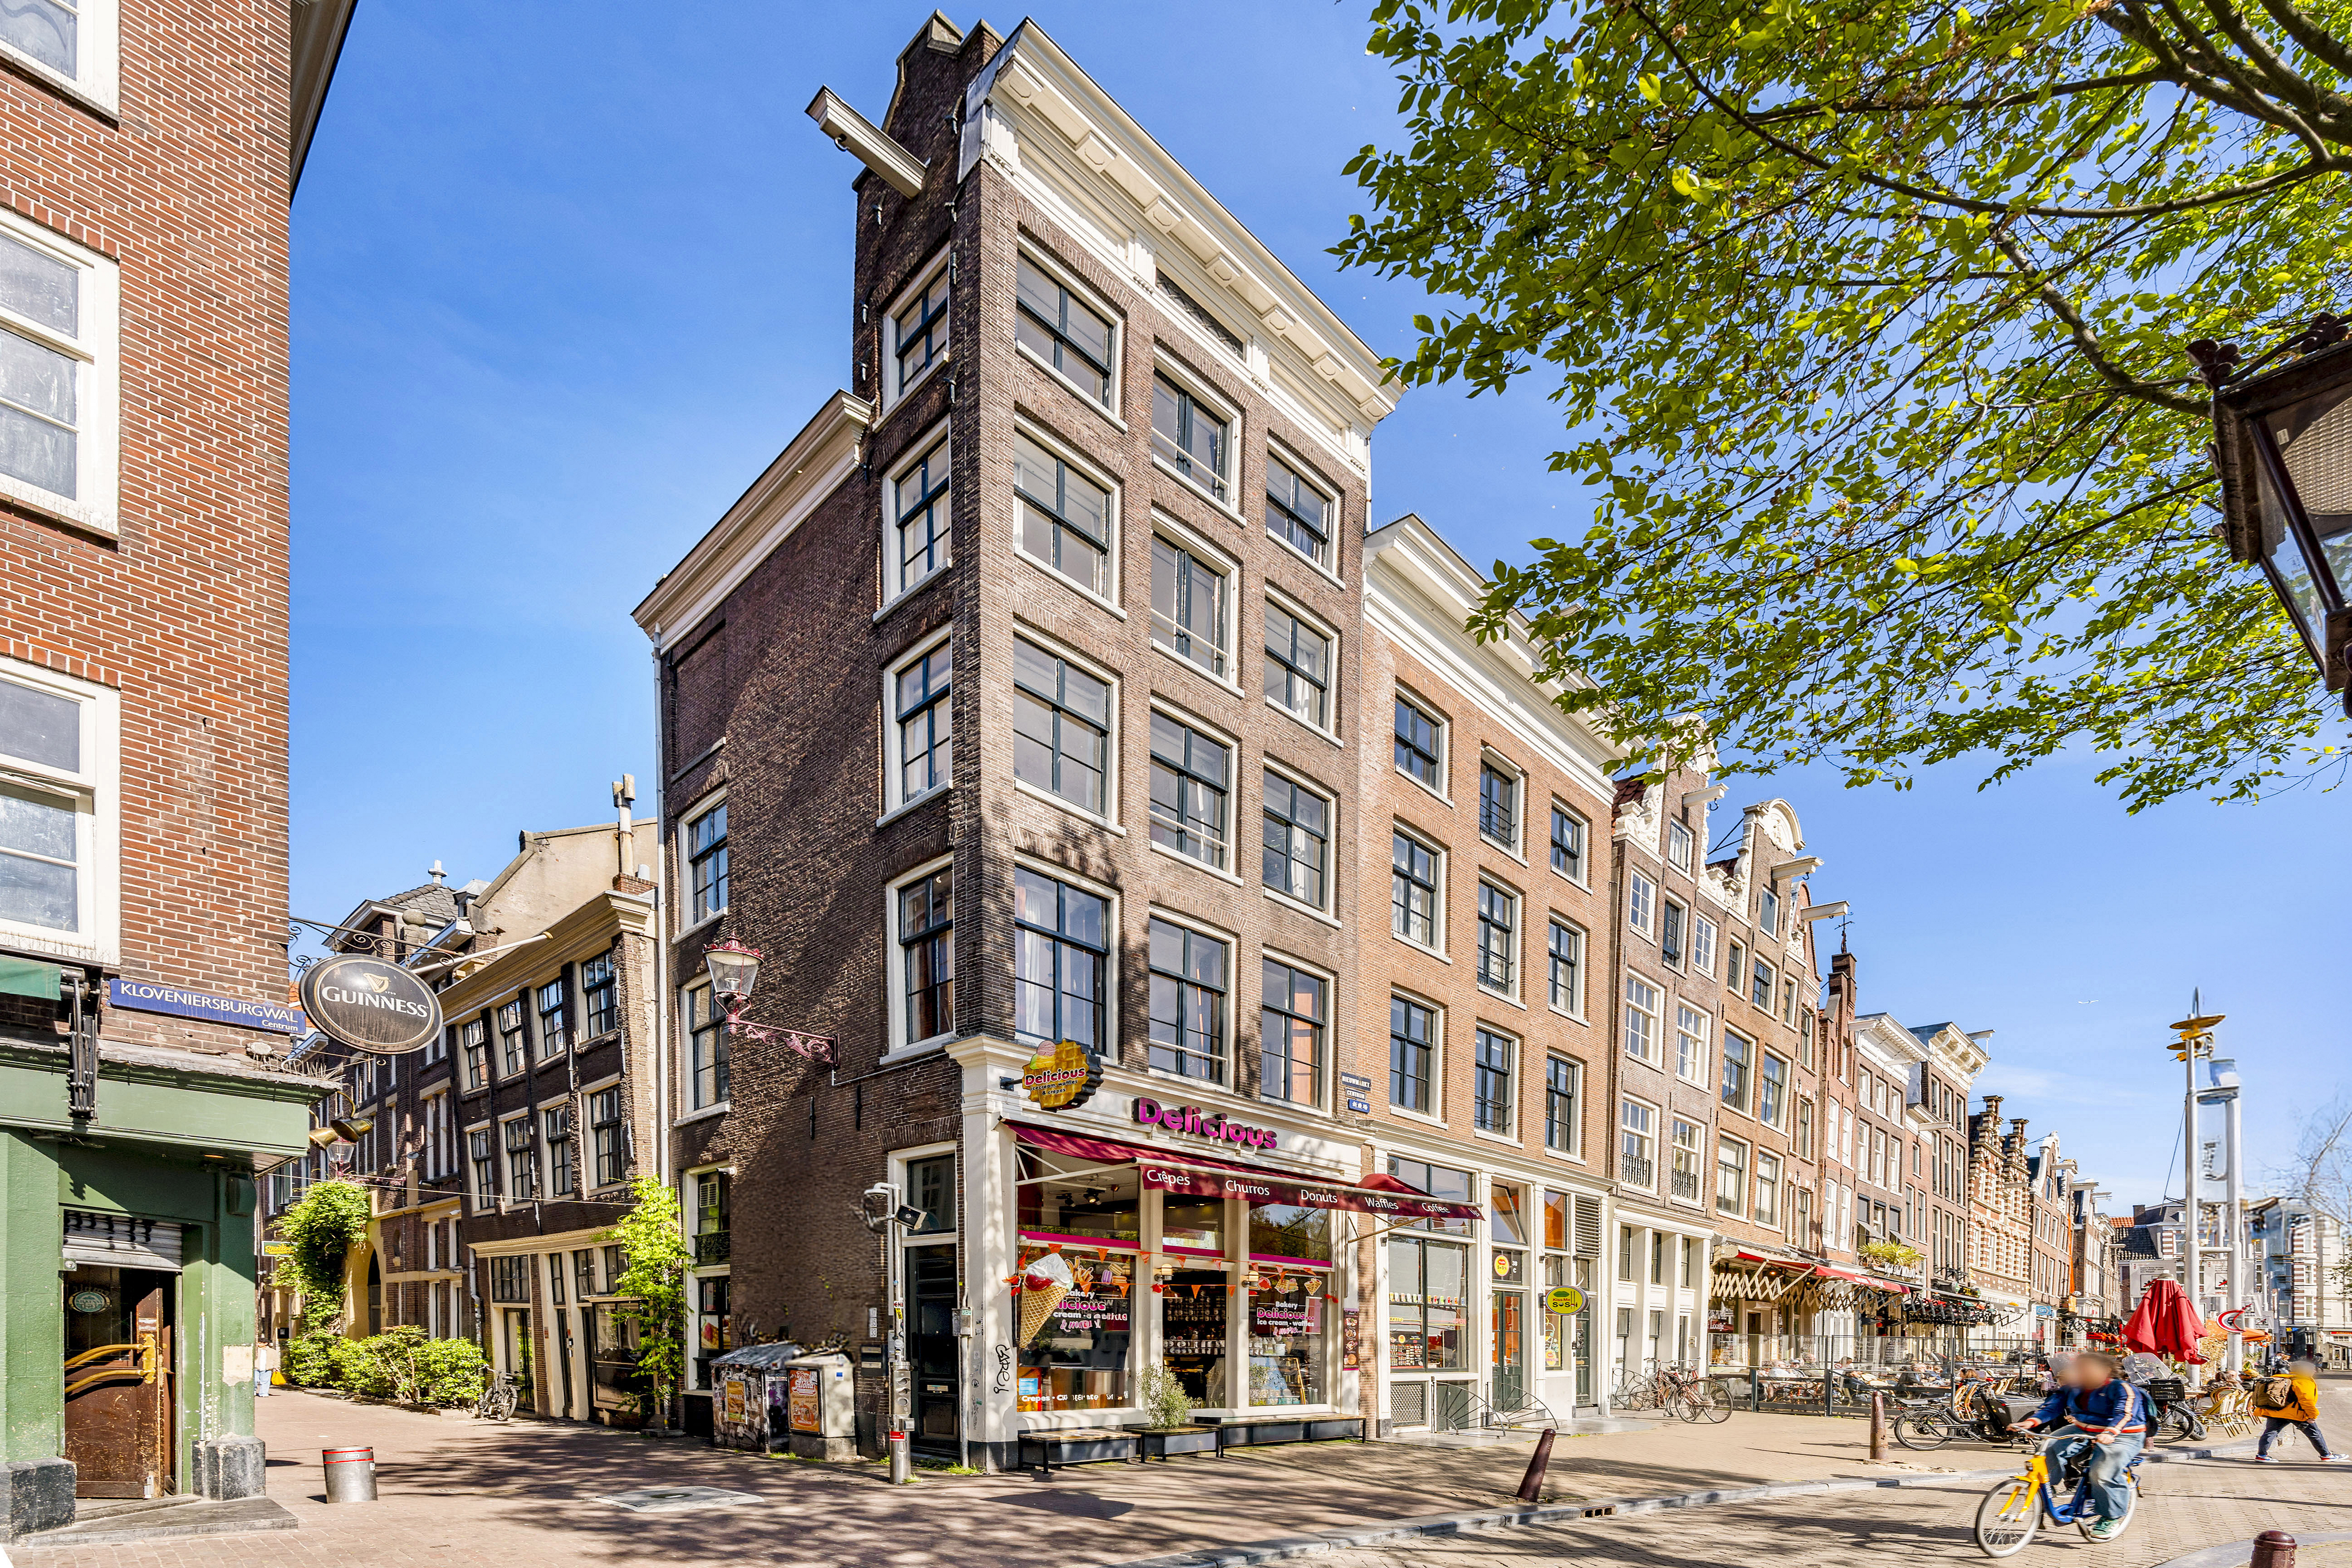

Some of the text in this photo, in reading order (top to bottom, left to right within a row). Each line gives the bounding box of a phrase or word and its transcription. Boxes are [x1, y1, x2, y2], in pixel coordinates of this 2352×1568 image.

[121, 982, 298, 1023] KLOVENIERSBURGWAL
[322, 986, 428, 1017] GUINNESS
[261, 1019, 299, 1032] Centrum
[1024, 1068, 1086, 1086] Delicious
[1132, 1097, 1278, 1149] Delicious
[1146, 1170, 1191, 1187] Crêpes
[1225, 1180, 1270, 1196] Churros
[1300, 1189, 1338, 1203] Donuts
[1364, 1197, 1399, 1210] Waffles
[1421, 1202, 1450, 1214] Coffee
[1057, 1296, 1106, 1310] licious
[1275, 1301, 1298, 1310] Bakery
[871, 1328, 877, 1337] 33
[795, 1380, 814, 1389] Aloha
[1021, 1395, 1051, 1403] Crepes
